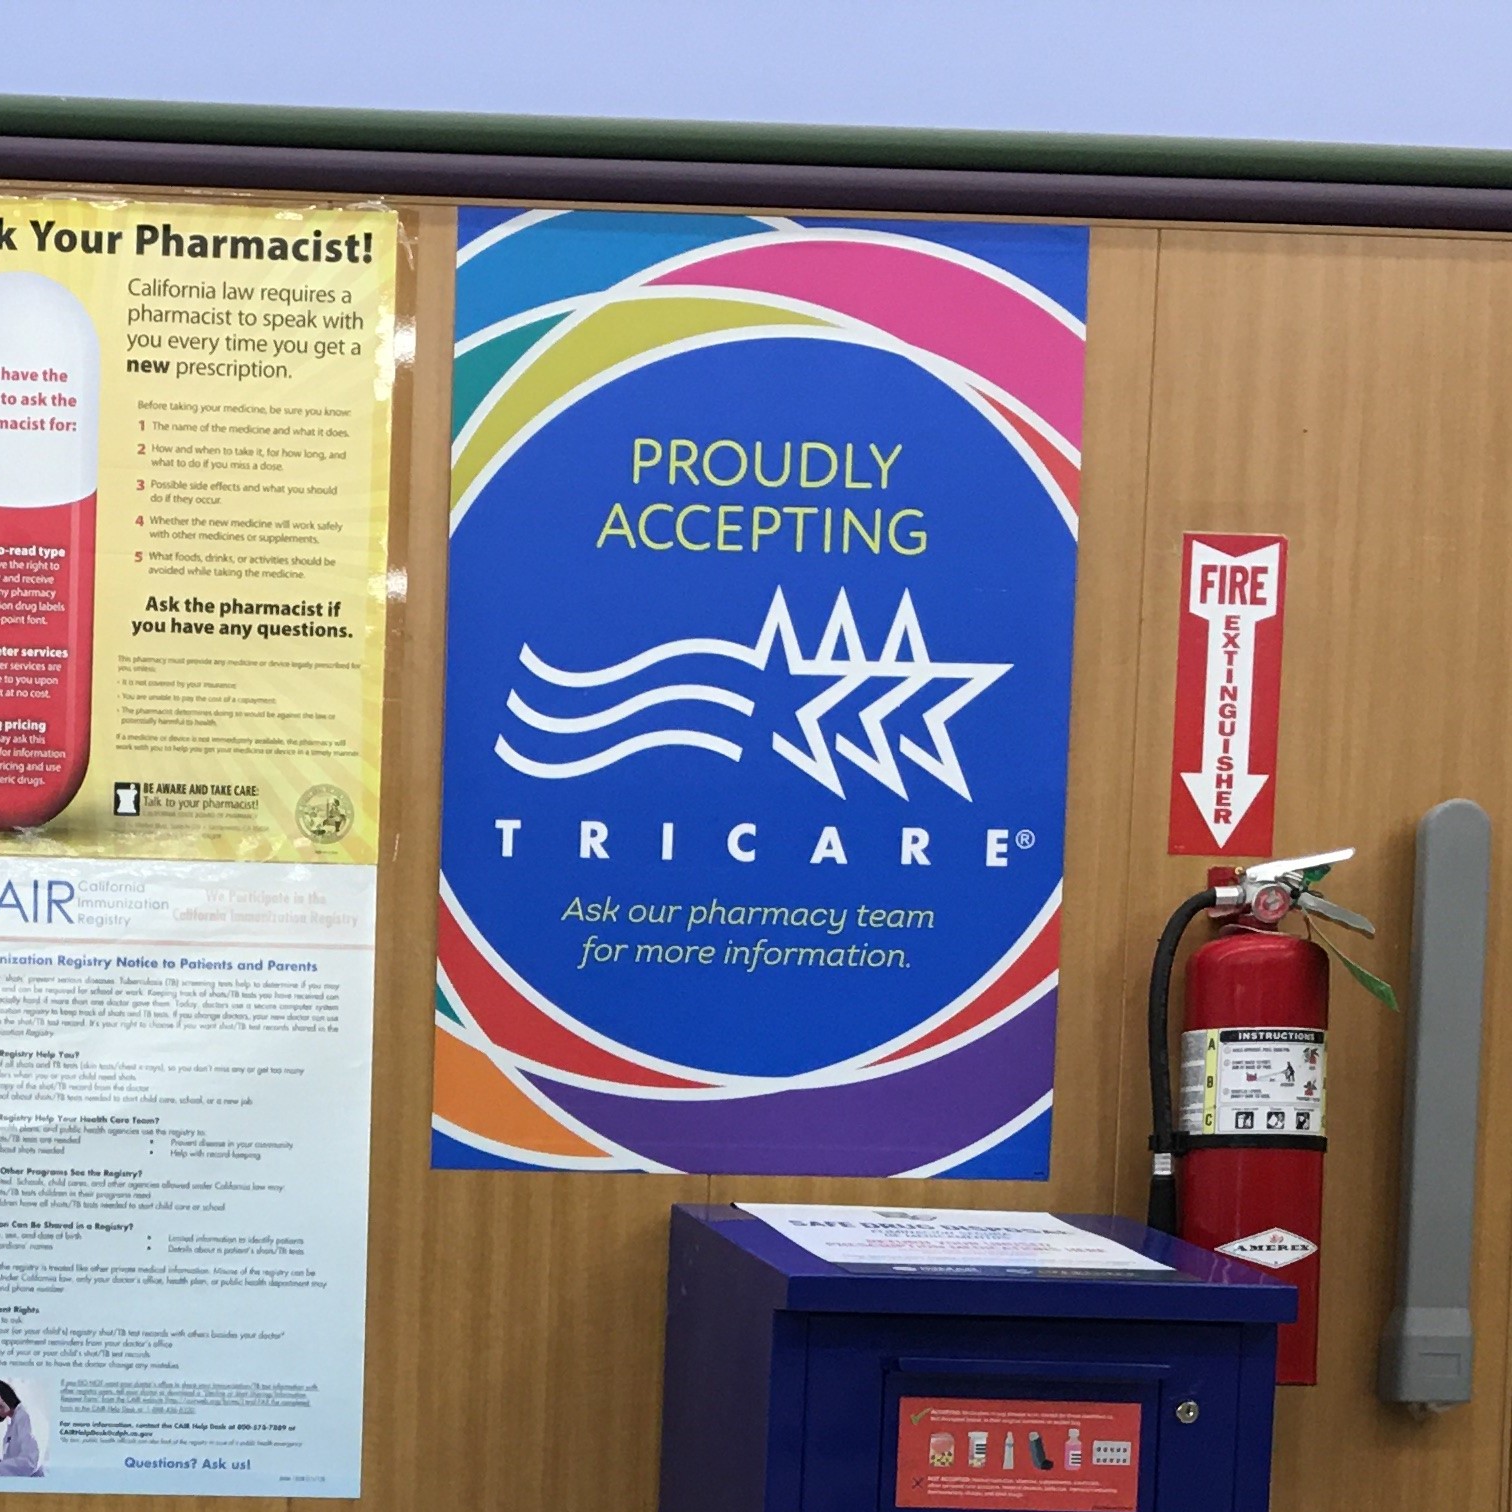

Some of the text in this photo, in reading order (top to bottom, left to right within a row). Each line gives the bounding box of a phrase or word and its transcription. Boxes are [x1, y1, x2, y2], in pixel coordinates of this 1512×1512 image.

[29, 219, 122, 254] Your
[135, 223, 372, 264] Pharmacist!
[128, 278, 351, 306] California law requires a
[128, 305, 363, 331] pharmacist to speak with
[127, 333, 361, 359] you every time you get a
[1, 366, 38, 381] have
[42, 368, 67, 382] the
[126, 359, 291, 381] new prescription.
[0, 392, 16, 405] to
[20, 392, 47, 406] ask
[51, 392, 77, 407] the
[137, 400, 167, 410] Before
[169, 401, 198, 414] taking
[200, 404, 221, 413] your
[223, 404, 267, 414] medicine,
[269, 405, 281, 414] be
[283, 407, 302, 415] sure
[304, 408, 322, 417] you
[49, 416, 76, 431] for:
[633, 437, 902, 489] PROUDLY
[596, 502, 926, 555] ACCEPTING
[38, 546, 65, 559] type
[1199, 564, 1268, 605] FIRE
[145, 596, 341, 617] Ask the pharmacist if
[131, 618, 353, 639] you have any questions.
[21, 646, 68, 658] services
[4, 718, 46, 733] pricing
[1213, 615, 1242, 827] EXTINGUISHER
[143, 782, 259, 796] BE AWARE AND TAKE CARE:
[142, 796, 258, 810] Talk to your pharmacist!
[77, 880, 149, 893] California
[76, 896, 169, 910] Immunization
[77, 913, 131, 928] Registry
[560, 896, 933, 934] Ask our pharmacy team
[576, 935, 910, 971] for more information.
[57, 955, 112, 970] Registry
[116, 955, 158, 968] Notice
[162, 958, 175, 968] to
[180, 958, 233, 970] Patients
[237, 959, 263, 970] and
[267, 959, 317, 972] Parents
[1238, 1031, 1314, 1040] INSTRUCTIONS
[1207, 1038, 1215, 1050] A
[1206, 1075, 1213, 1088] B
[1205, 1113, 1212, 1126] C
[13, 1305, 39, 1315] Rights
[124, 1456, 250, 1469] Questions? Ask us!
